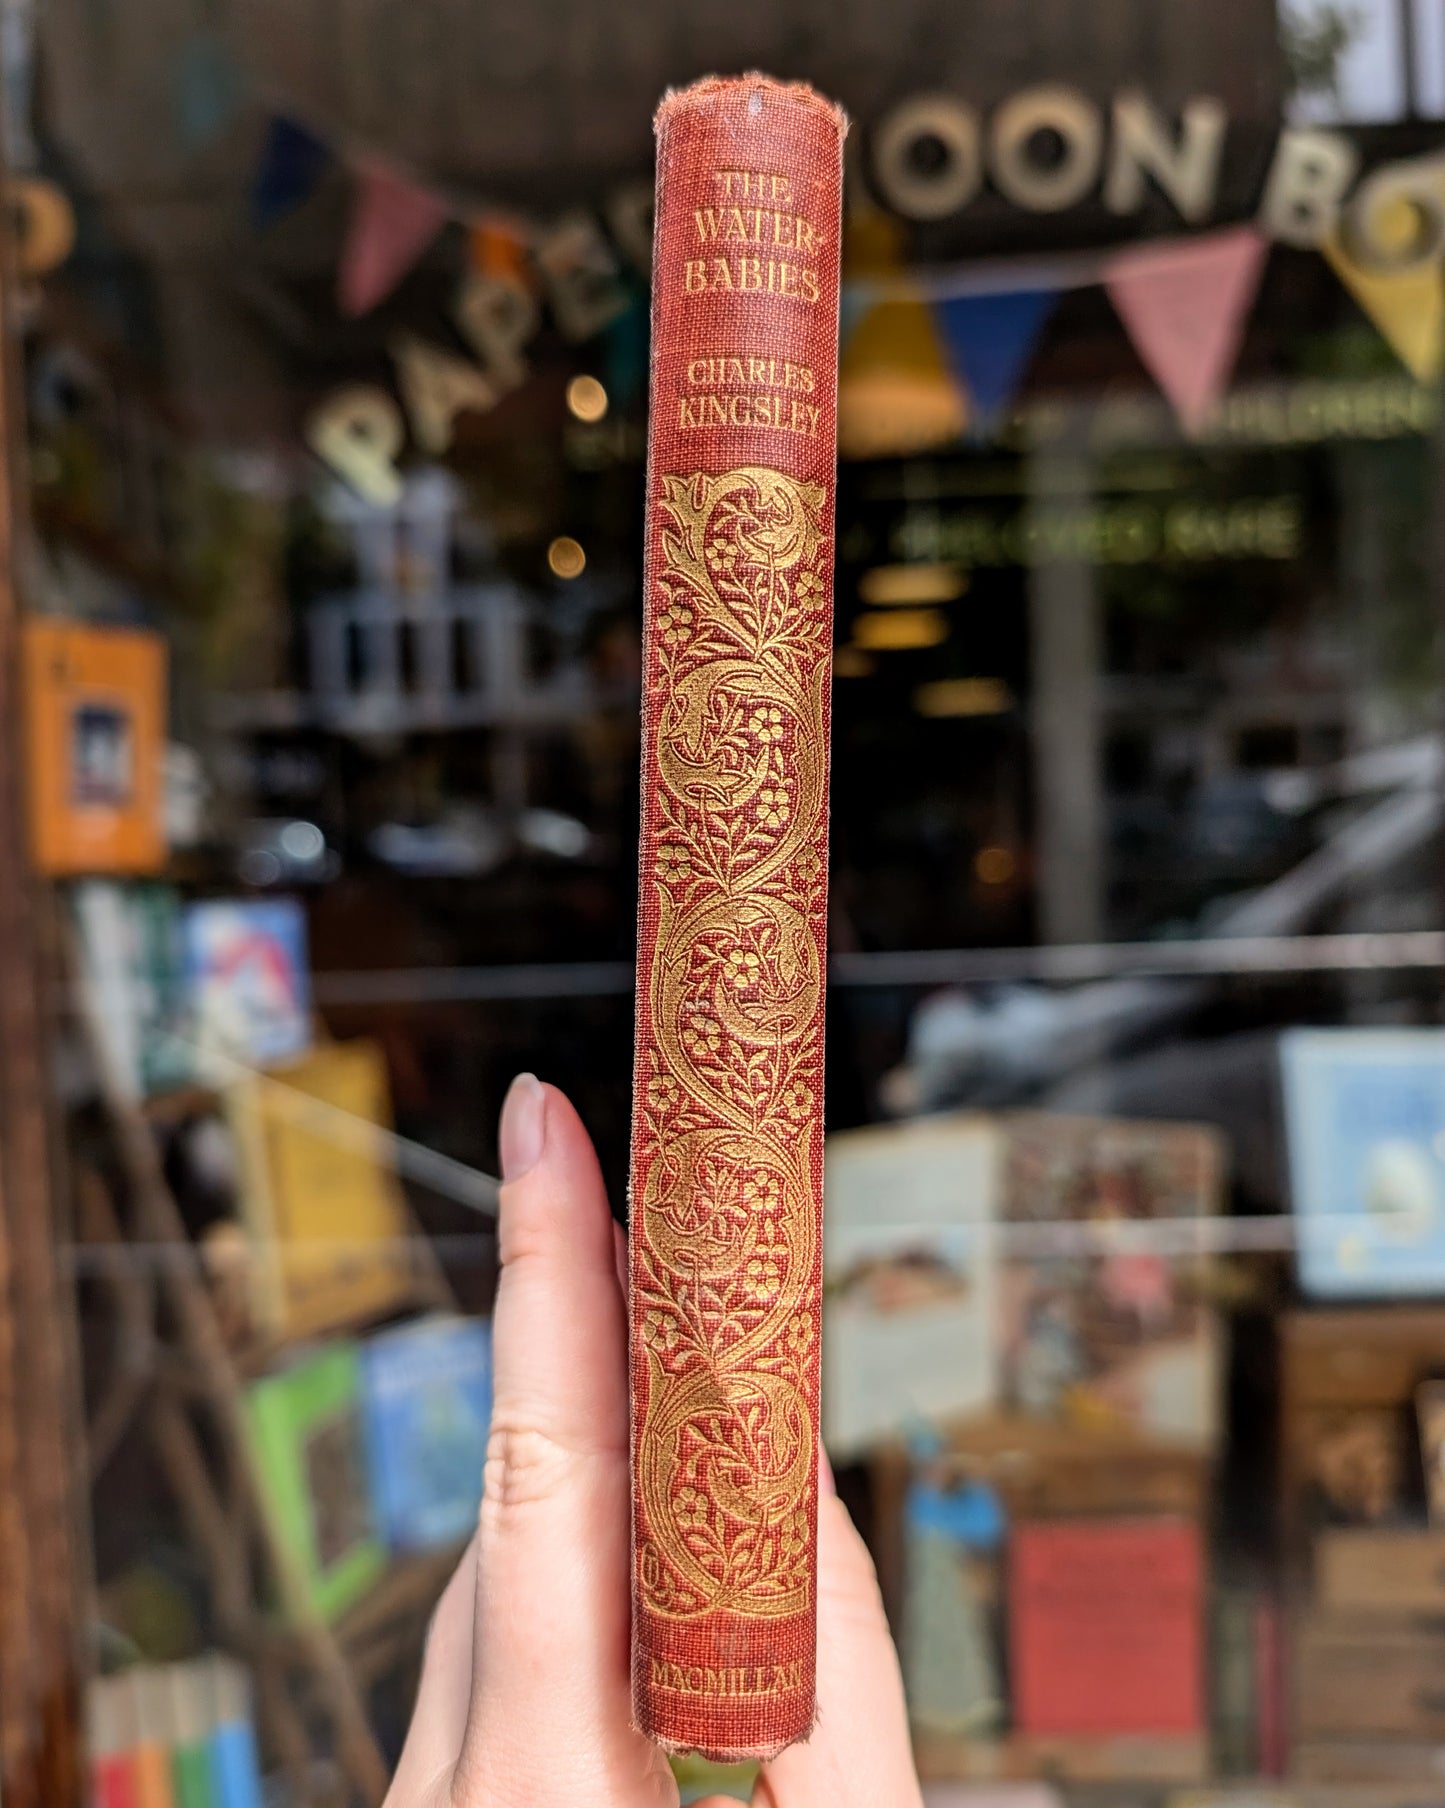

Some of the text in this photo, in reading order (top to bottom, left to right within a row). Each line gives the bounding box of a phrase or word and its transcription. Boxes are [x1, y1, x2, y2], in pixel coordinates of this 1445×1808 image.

[715, 168, 792, 202] THE
[685, 256, 820, 302] BABIES
[687, 357, 814, 393] CHARLES
[679, 394, 823, 436] KINGSLEY
[651, 1658, 803, 1697] MACMILLAN
